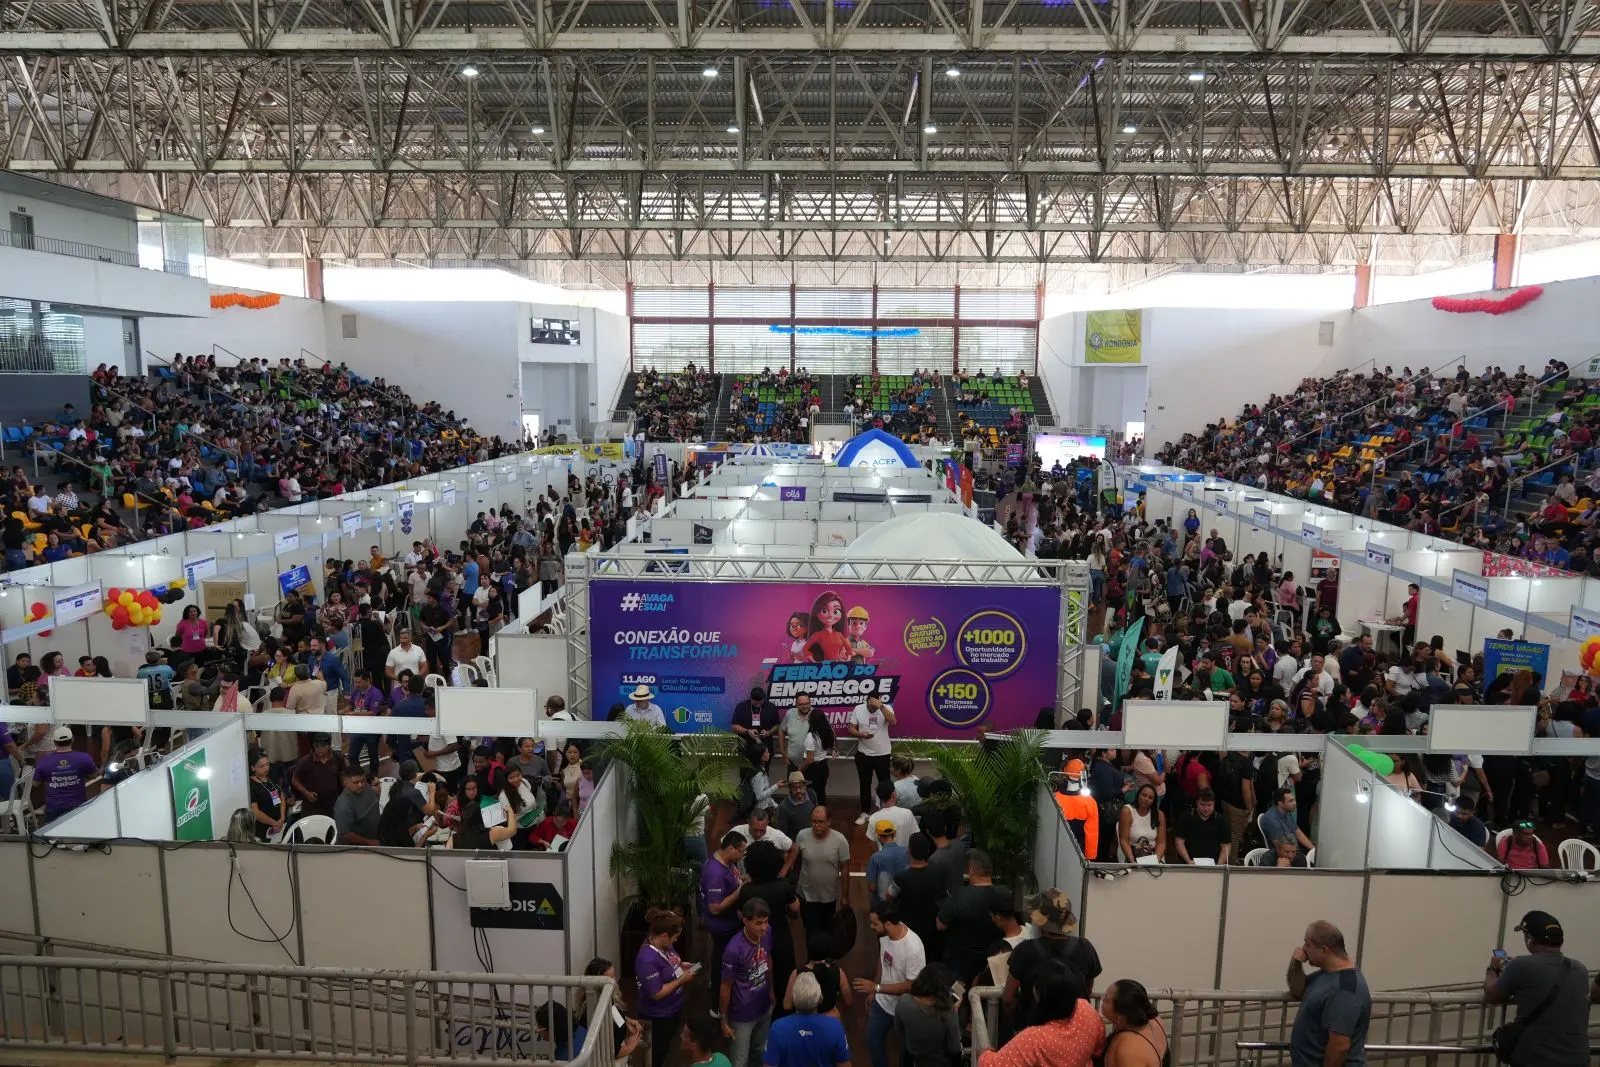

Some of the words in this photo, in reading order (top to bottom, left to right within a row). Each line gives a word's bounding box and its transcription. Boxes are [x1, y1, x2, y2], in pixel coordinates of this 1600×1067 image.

[873, 458, 897, 467] ACEP
[912, 623, 937, 632] EVENTO
[614, 626, 690, 645] CONEXÃO
[693, 631, 721, 645] QUE
[910, 629, 940, 638] GRATUITO
[908, 636, 934, 644] ABERTO
[965, 646, 1015, 654] Oportunidades
[1488, 643, 1515, 651] TEMOS
[629, 644, 738, 660] TRANSFORMA
[773, 660, 848, 682] FEIRÃO
[853, 664, 876, 676] DO
[769, 678, 876, 697] EMPREGO
[878, 678, 893, 693] E
[936, 683, 978, 700] +150
[51, 775, 78, 783] Posso
